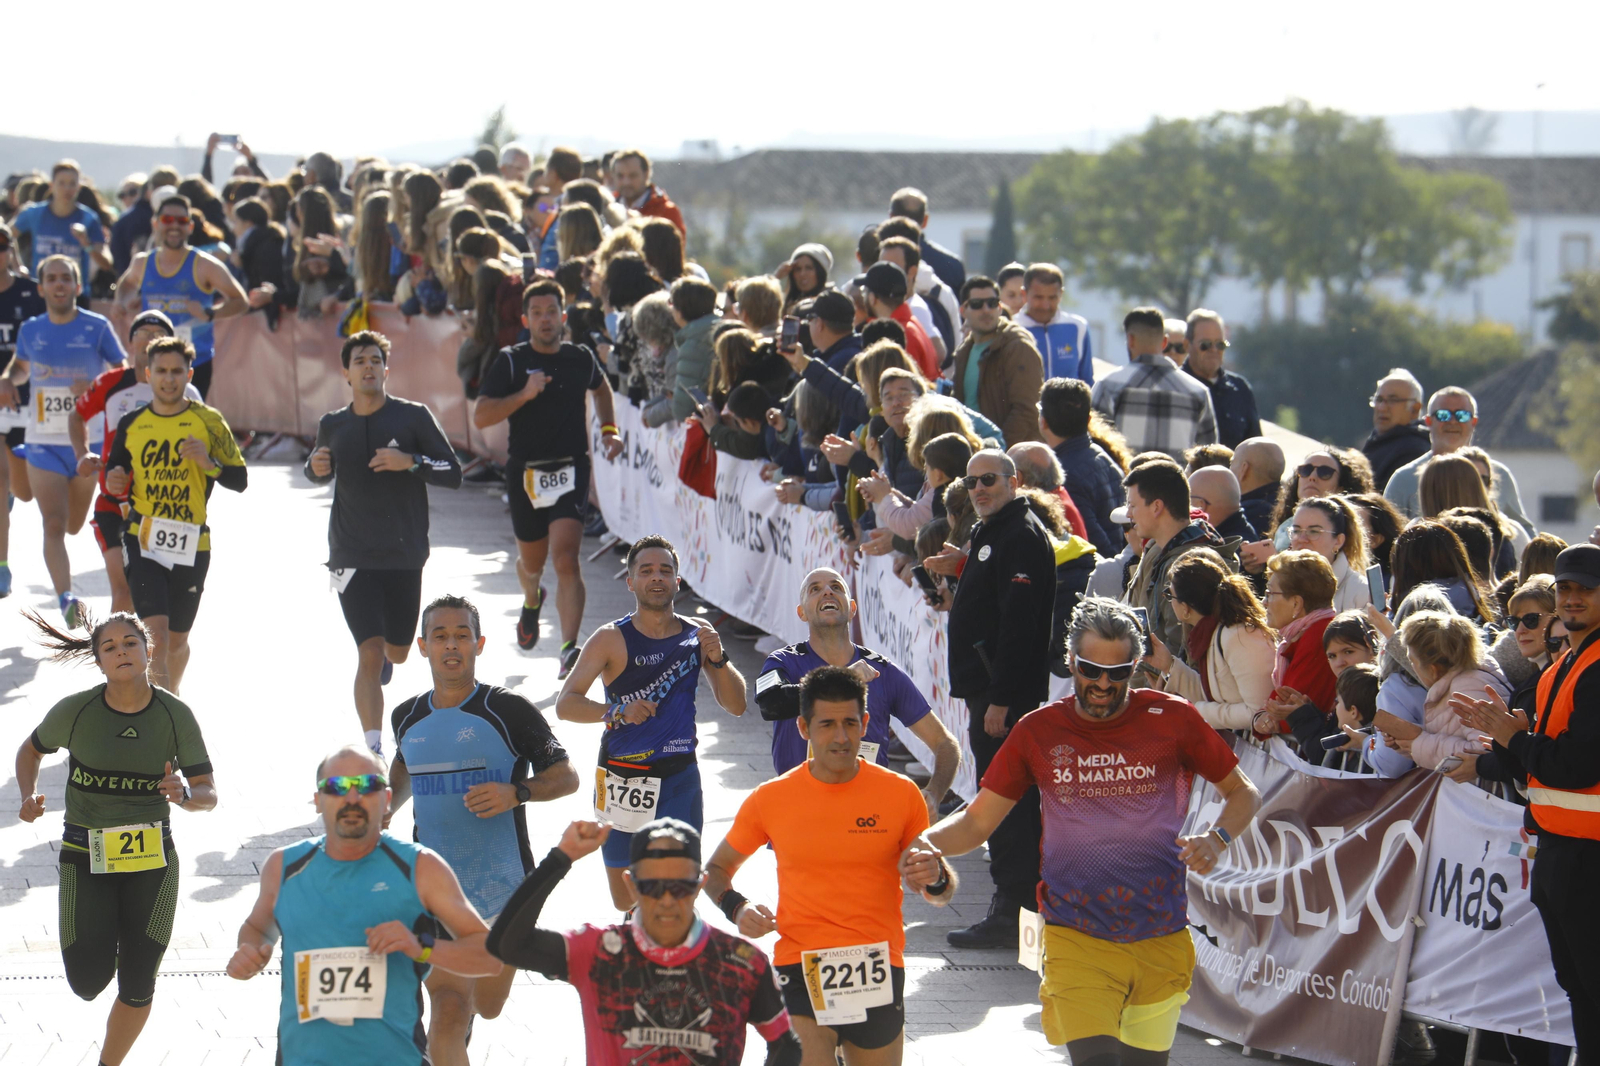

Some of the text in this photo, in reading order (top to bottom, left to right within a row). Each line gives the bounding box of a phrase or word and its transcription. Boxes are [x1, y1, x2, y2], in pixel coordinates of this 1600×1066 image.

[141, 438, 187, 468] GAS
[153, 468, 189, 481] FONDO
[539, 471, 568, 489] 686
[145, 484, 190, 501] MADA
[152, 501, 194, 523] FAKA
[155, 529, 188, 551] 931
[461, 758, 487, 769] BAENA
[1077, 752, 1127, 768] MEDIA
[1052, 761, 1156, 784] 36 MARATÓN
[607, 784, 655, 809] 1765
[1135, 783, 1157, 794] 2022
[856, 817, 876, 827] GO
[119, 831, 145, 855] 21
[320, 951, 356, 961] IMDECO
[829, 949, 862, 959] IMDECO
[319, 966, 373, 995] 974
[821, 959, 887, 990] 2215
[1262, 954, 1336, 999] Deportes
[1340, 968, 1392, 1013] Córdob
